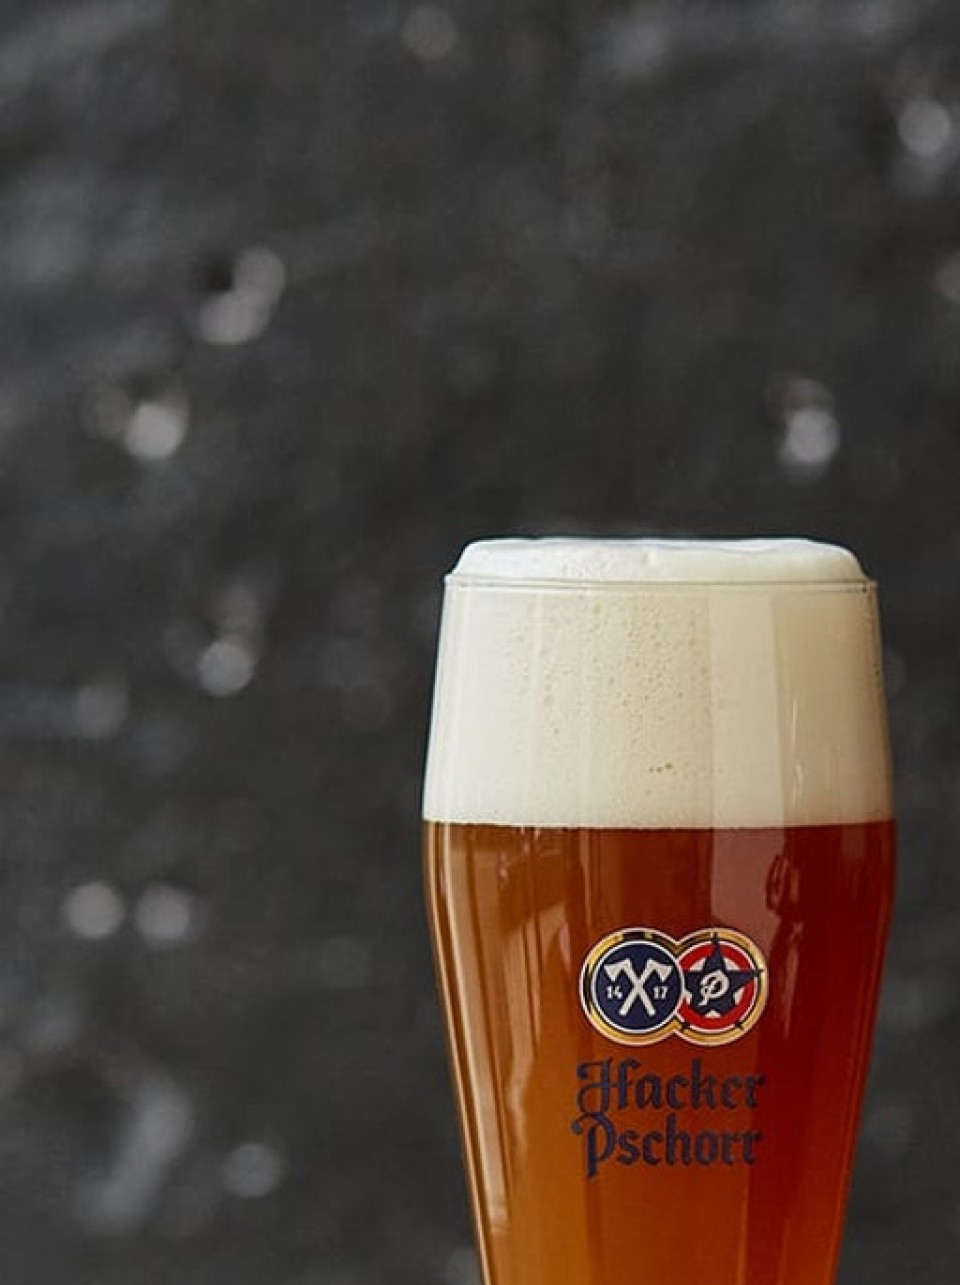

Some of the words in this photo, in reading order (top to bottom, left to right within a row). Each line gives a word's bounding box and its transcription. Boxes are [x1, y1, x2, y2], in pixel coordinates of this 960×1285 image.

[607, 986, 623, 999] 14
[653, 986, 669, 999] 17
[577, 1057, 765, 1112] Hacker
[572, 1112, 761, 1178] Pschorr
